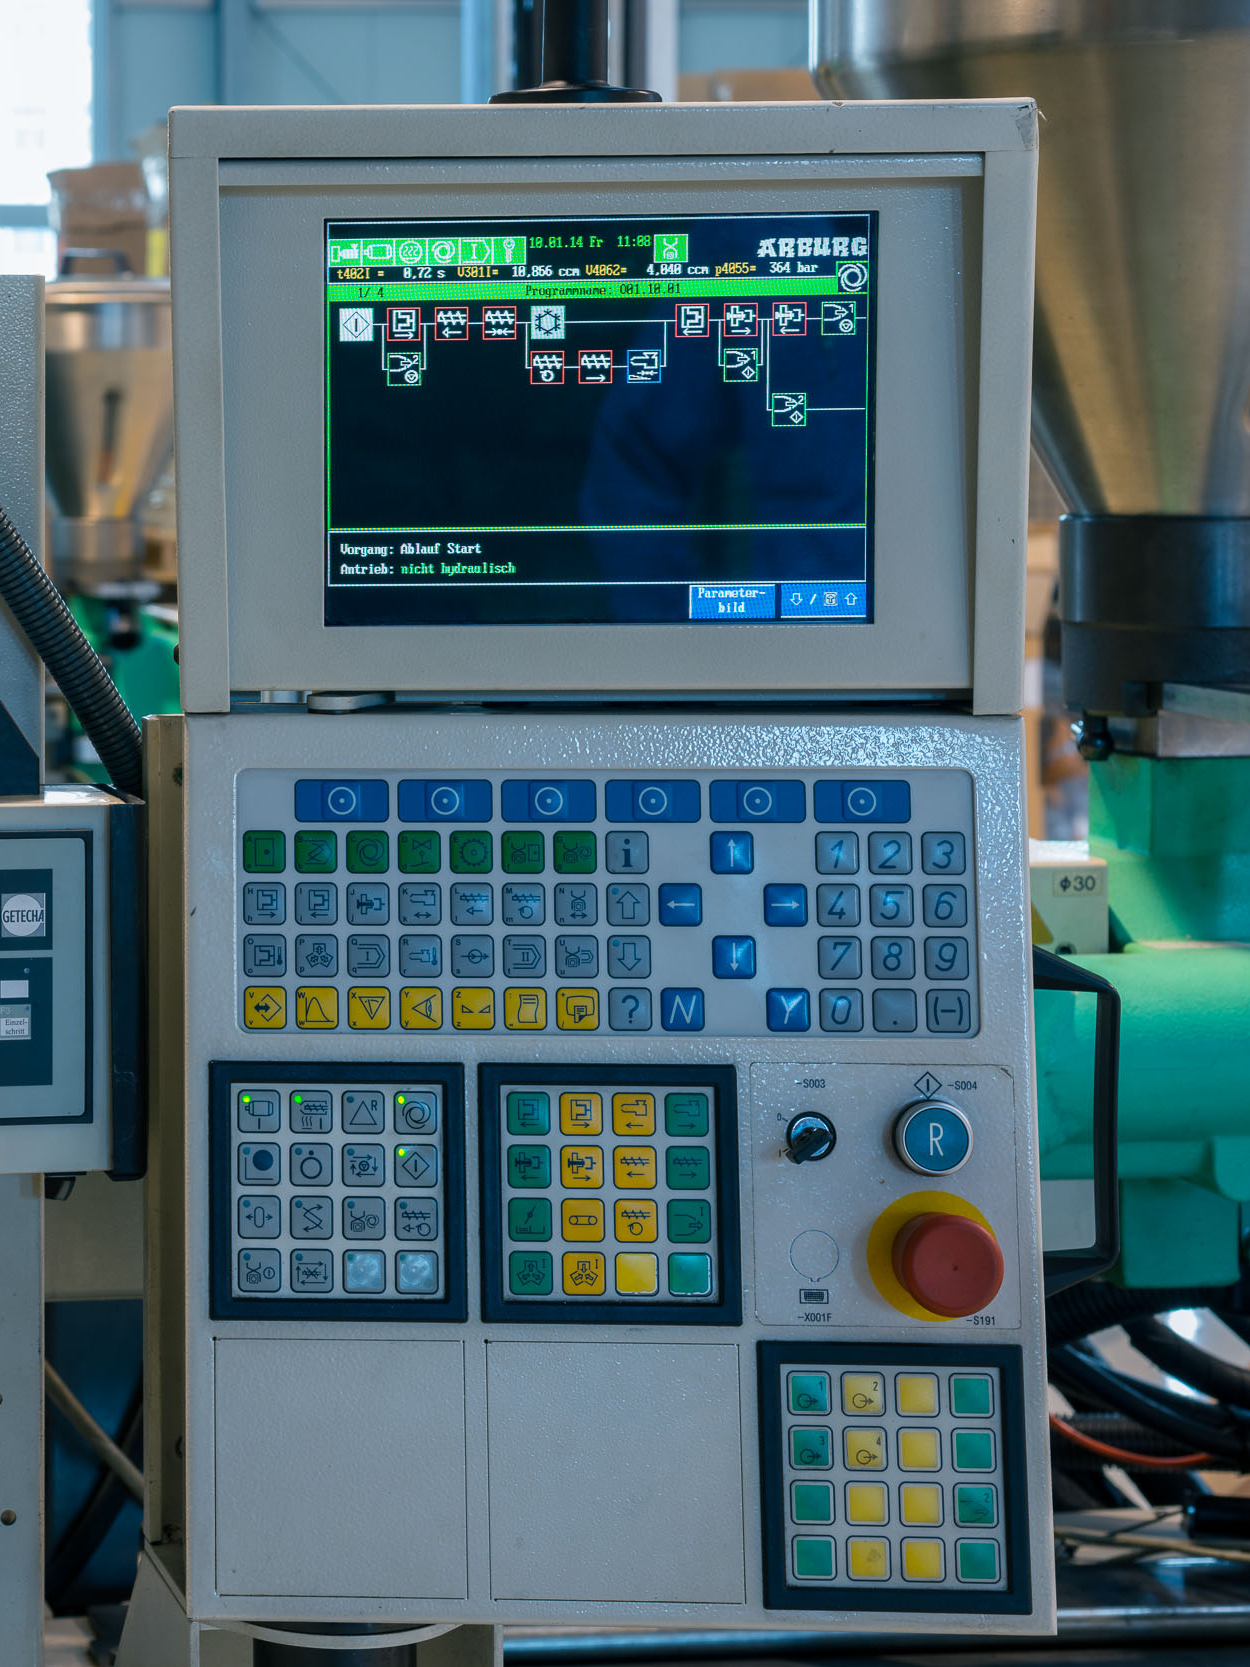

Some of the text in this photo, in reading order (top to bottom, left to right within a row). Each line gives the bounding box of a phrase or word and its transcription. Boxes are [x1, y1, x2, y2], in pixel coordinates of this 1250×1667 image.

[529, 235, 651, 248] 10.01.14 Fr 11:08
[757, 237, 868, 258] ARBURG
[558, 267, 580, 276] ccm
[687, 265, 709, 274] ccm
[769, 261, 791, 274] 364
[797, 261, 818, 273] bar
[340, 543, 482, 557] Vorgang: Ablauf Start
[340, 562, 516, 576] Antrieb: nicht hydraulisch
[698, 588, 765, 598] Parameter-
[718, 602, 745, 613] bild
[830, 839, 844, 869] 1
[878, 839, 901, 869] 2
[931, 839, 955, 869] 3
[2, 910, 44, 923] GETECHA
[828, 891, 846, 920] 4
[879, 890, 904, 921] 5
[934, 891, 957, 921] 6
[831, 941, 852, 971] 7
[882, 942, 902, 972] 8
[935, 942, 958, 972] 9
[669, 995, 697, 1024] N
[780, 995, 804, 1024] Y
[929, 1122, 944, 1156] R
